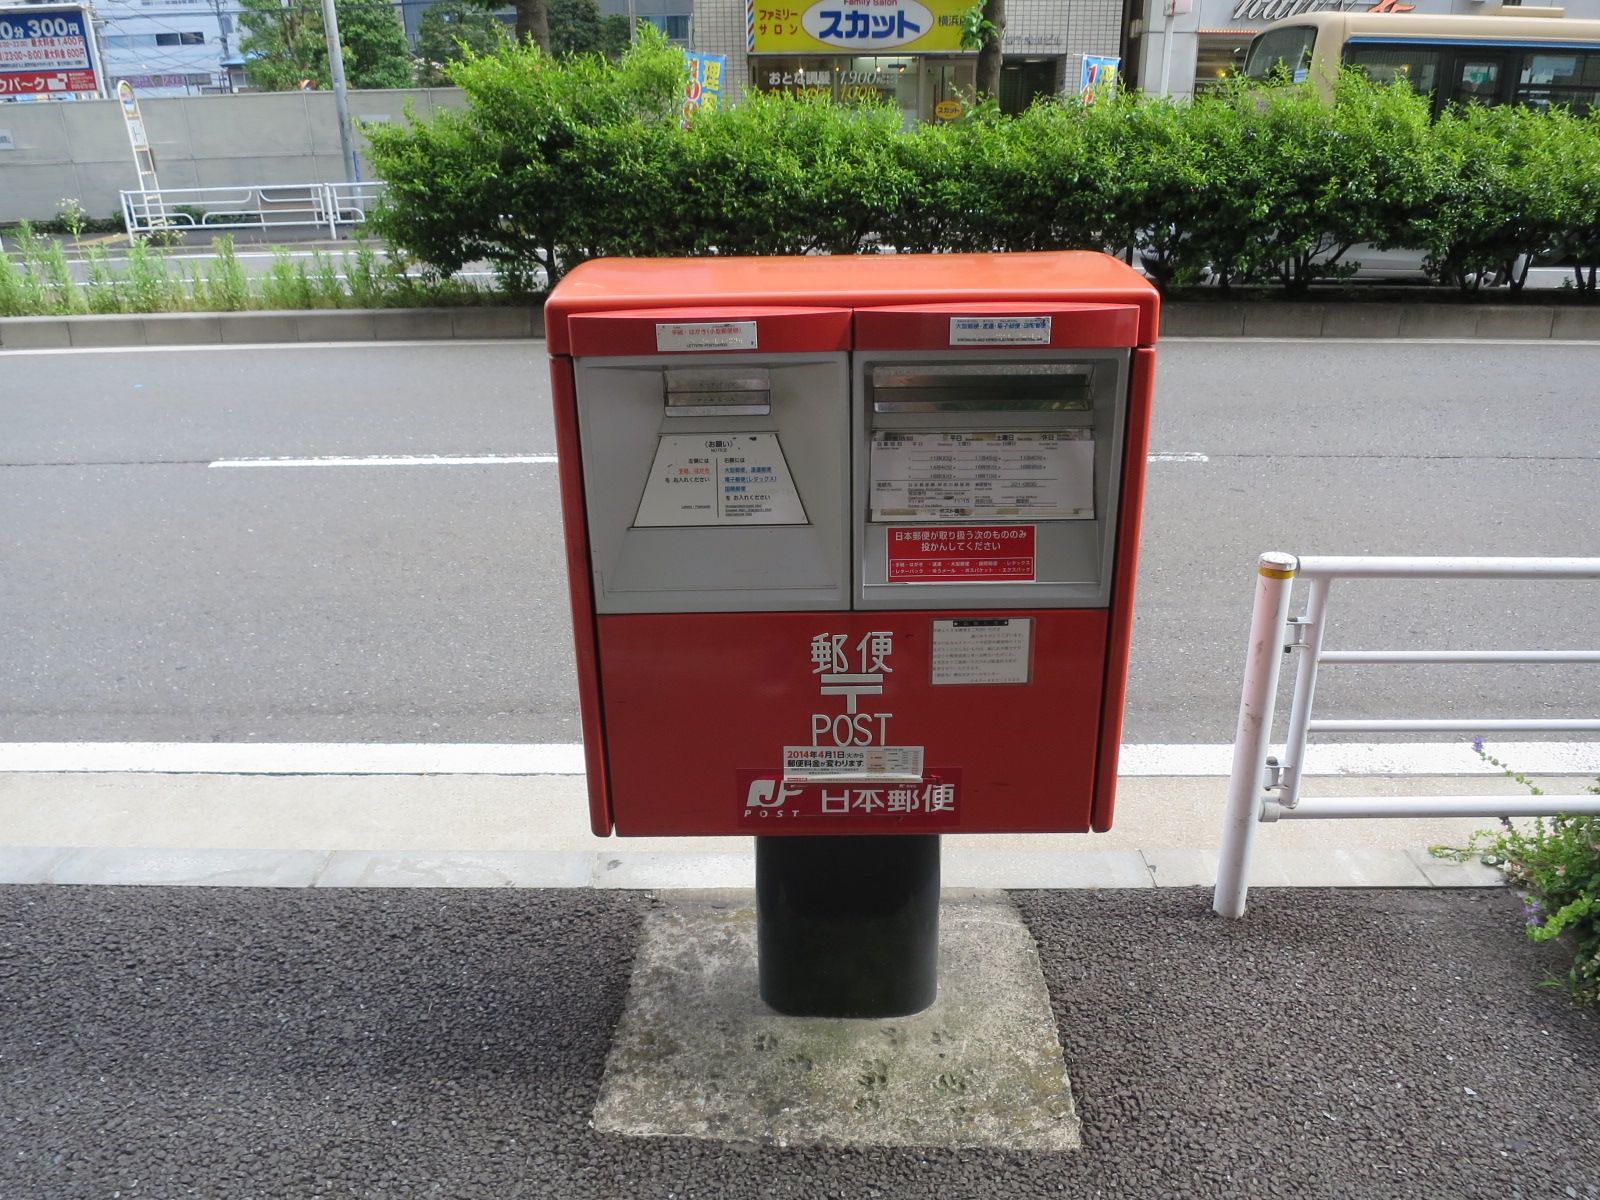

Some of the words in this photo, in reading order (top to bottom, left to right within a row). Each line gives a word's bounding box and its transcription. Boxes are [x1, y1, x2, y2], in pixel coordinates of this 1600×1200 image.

[759, 9, 798, 21] ファミリー
[759, 24, 798, 36] サロン
[819, 10, 920, 39] スカット
[895, 530, 1027, 541] 日本郵便が取り扱う次のもののみ
[921, 542, 1001, 552] 投かんしてください
[811, 631, 893, 674] 郵便
[811, 713, 893, 747] POST
[821, 783, 955, 813] 日本郵便
[744, 809, 800, 818] POST
